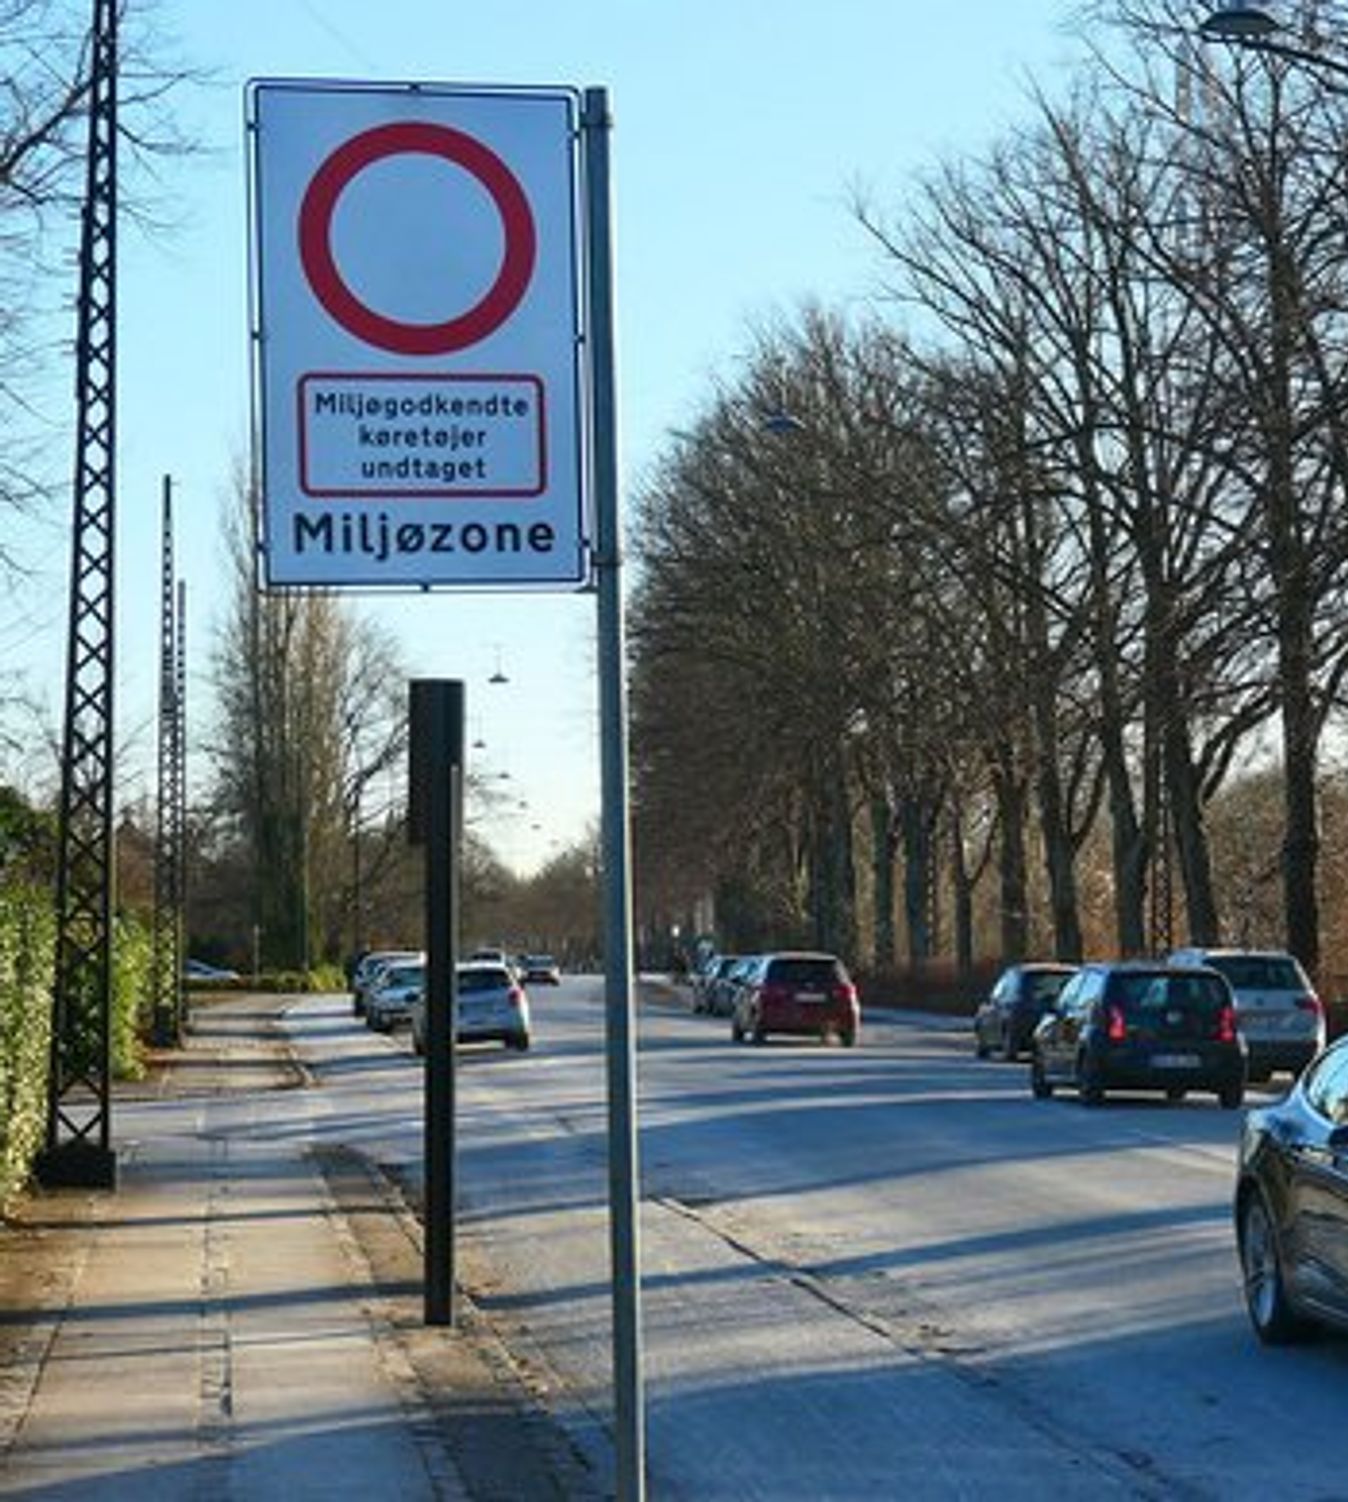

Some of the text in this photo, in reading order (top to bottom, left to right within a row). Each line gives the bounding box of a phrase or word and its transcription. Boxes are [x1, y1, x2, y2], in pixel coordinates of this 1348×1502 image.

[315, 393, 530, 419] Miljøgodkendte
[358, 427, 487, 451] køretøjer
[361, 457, 487, 482] undtaget
[293, 512, 556, 562] Miljøzone
